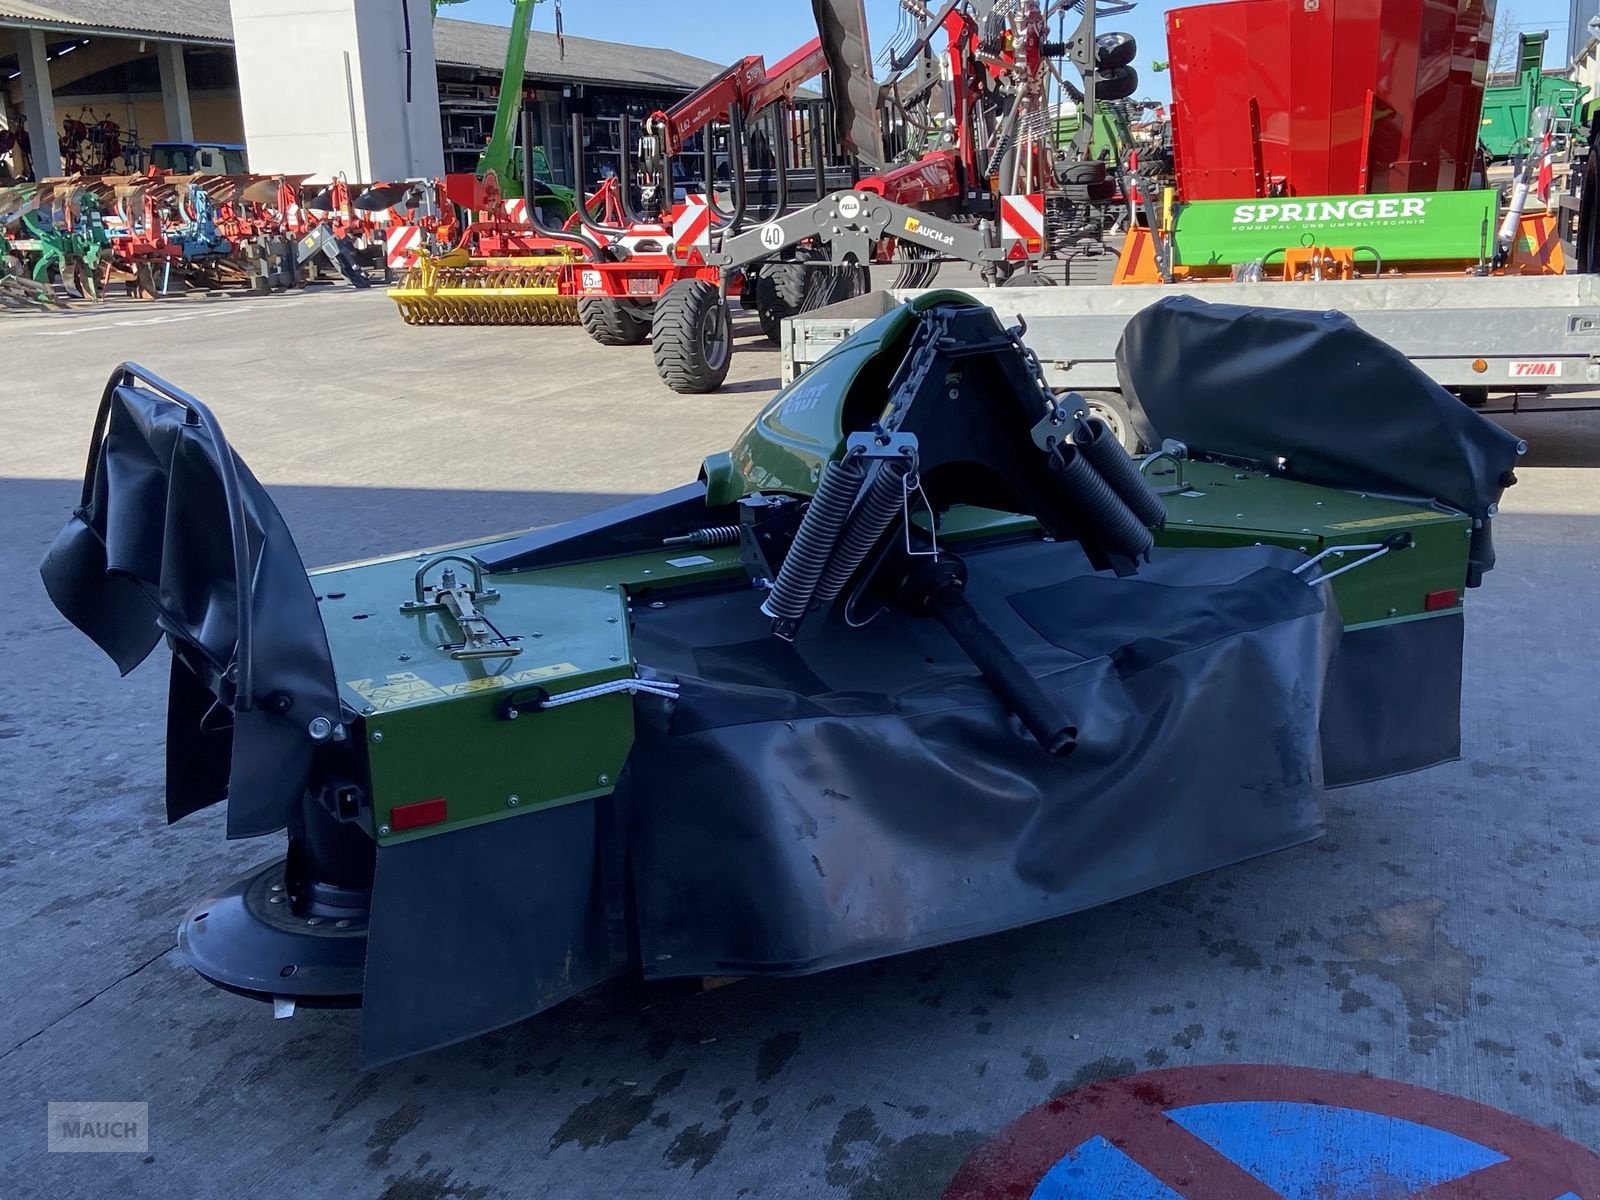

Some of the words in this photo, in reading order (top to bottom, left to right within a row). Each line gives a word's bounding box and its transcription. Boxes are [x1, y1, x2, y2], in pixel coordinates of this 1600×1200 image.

[1233, 198, 1426, 224] SPRINGER
[1330, 219, 1425, 228] UMWELTTECHNIK
[765, 227, 781, 245] 40
[908, 222, 955, 246] MAUCH.at
[583, 273, 594, 287] 25
